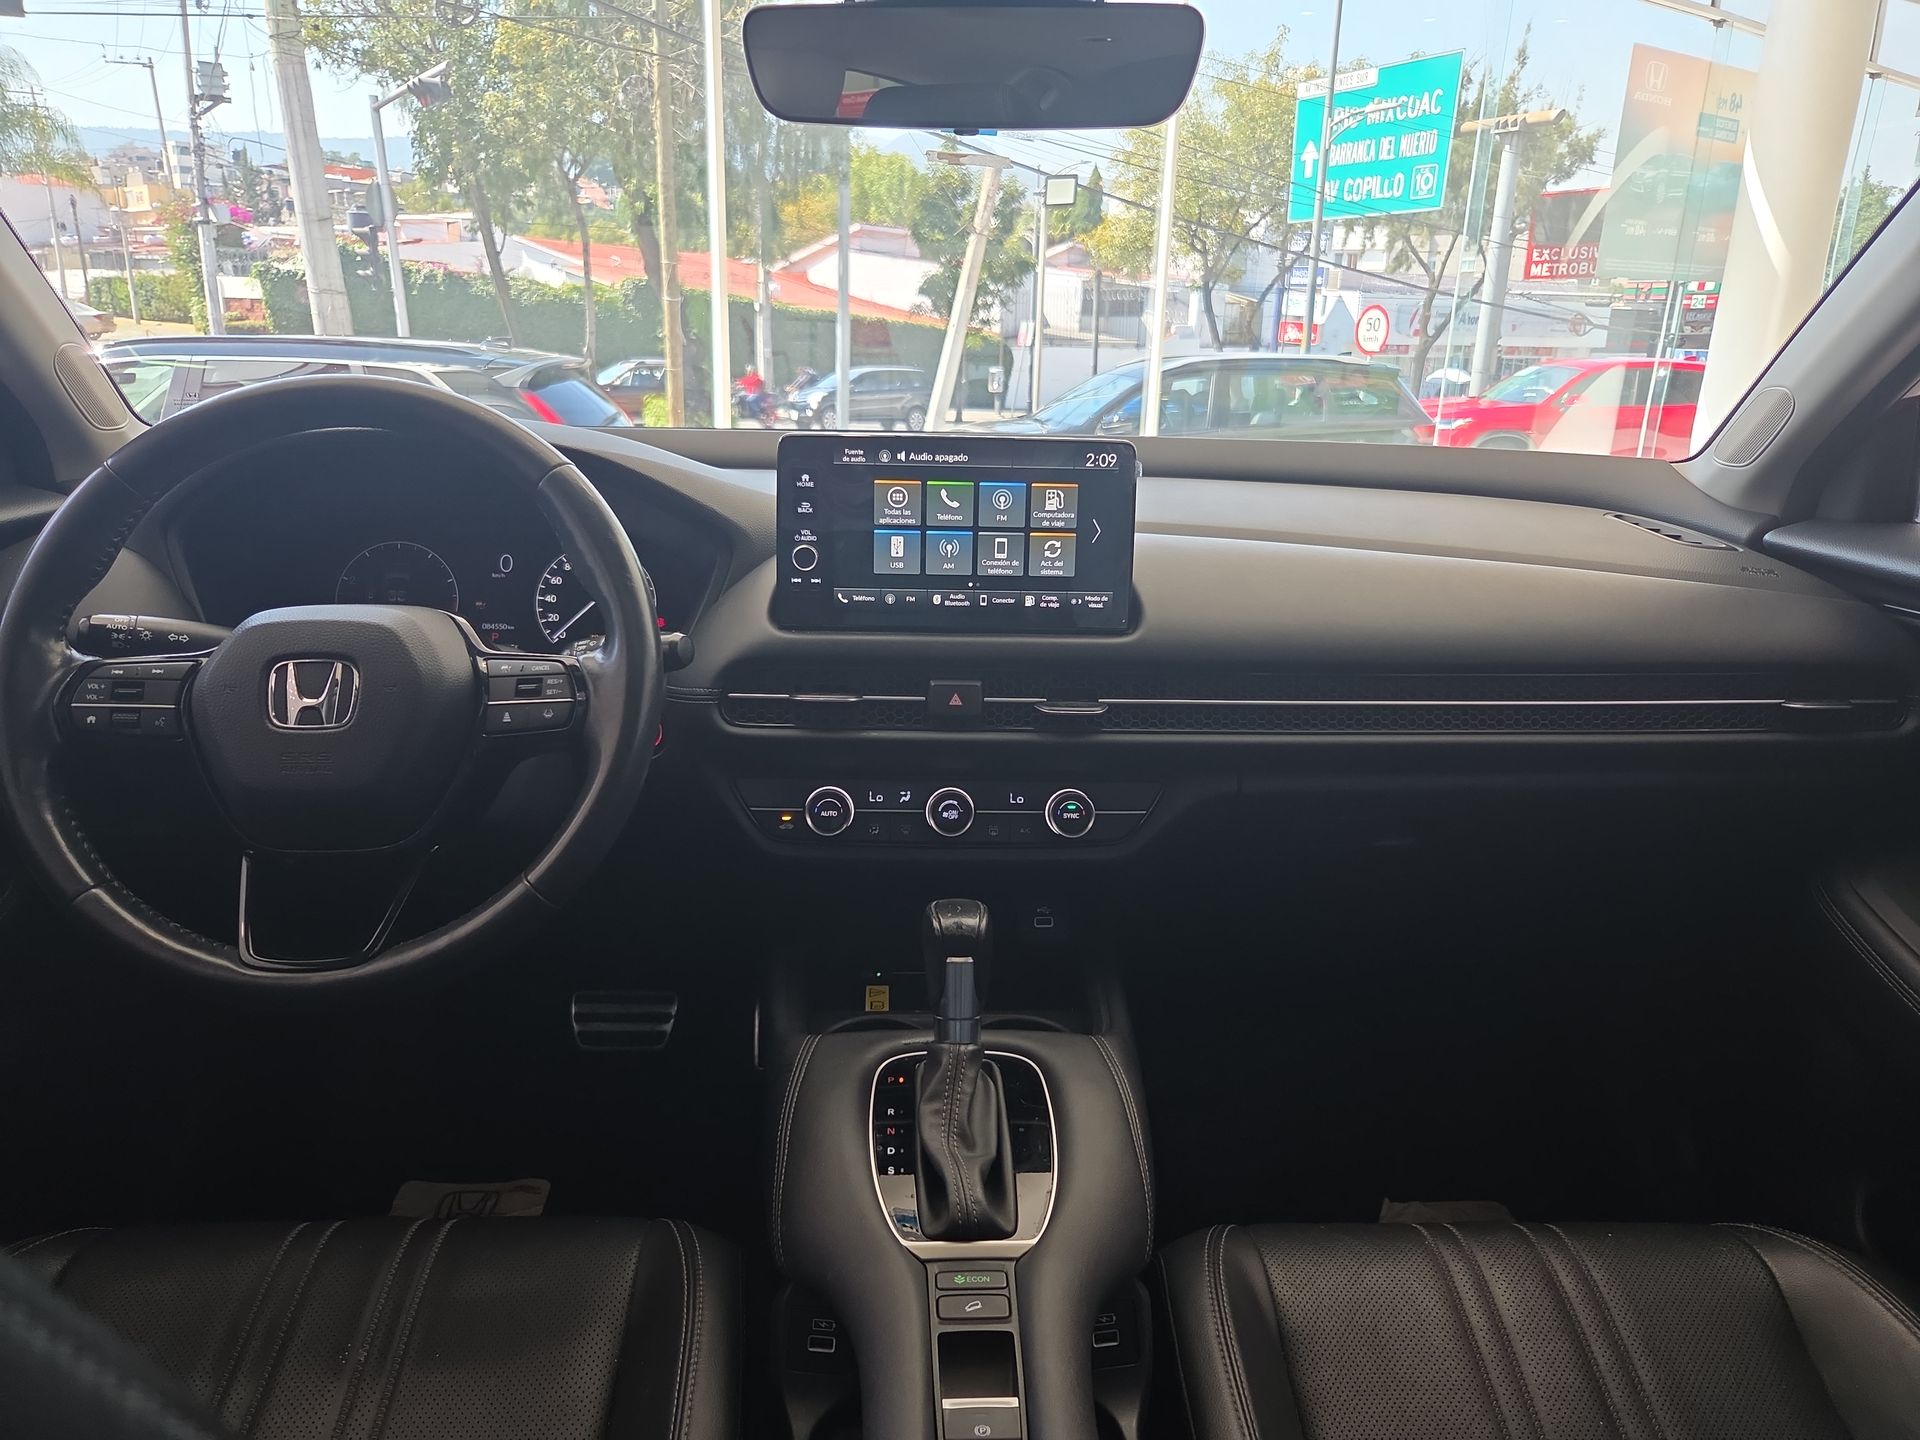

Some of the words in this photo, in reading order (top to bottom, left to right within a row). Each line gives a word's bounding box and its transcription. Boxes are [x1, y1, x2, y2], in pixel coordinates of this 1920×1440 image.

[1329, 138, 1375, 167] BARRANCA
[1378, 135, 1396, 161] DEL
[1400, 129, 1438, 158] MUERTO
[1415, 172, 1434, 191] 10
[1691, 295, 1705, 309] 24
[1366, 317, 1381, 332] 50
[844, 448, 864, 456] Fuente
[909, 452, 933, 462] Audio
[934, 453, 969, 464] apagado
[1085, 453, 1118, 468] 2:09
[884, 508, 902, 516] Todas
[903, 508, 912, 516] las
[1032, 511, 1075, 519] Computadora
[879, 517, 916, 525] aplicaciones
[936, 513, 963, 522] Teléfono
[996, 514, 1008, 522] FM
[1051, 520, 1065, 528] viaje
[500, 554, 513, 573] 0
[890, 561, 904, 570] USB
[942, 562, 955, 570] AM
[981, 559, 1010, 567] Conexión
[1040, 560, 1052, 568] Act.
[1053, 560, 1064, 568] del
[987, 568, 1014, 576] teléfono
[550, 576, 563, 585] 60
[544, 594, 557, 603] 40
[991, 597, 1016, 605] Conectar
[1041, 594, 1059, 602] Comp.
[944, 599, 971, 607] Bluetooth
[547, 613, 560, 622] 20
[106, 623, 128, 631] AUTO
[491, 632, 499, 641] P
[868, 790, 884, 802] Lo
[1009, 792, 1024, 804] Lo
[887, 1075, 895, 1084] P
[887, 1107, 895, 1117] R
[887, 1126, 896, 1136] N
[886, 1145, 896, 1156] D
[887, 1165, 895, 1175] S
[966, 1274, 990, 1283] ECON
